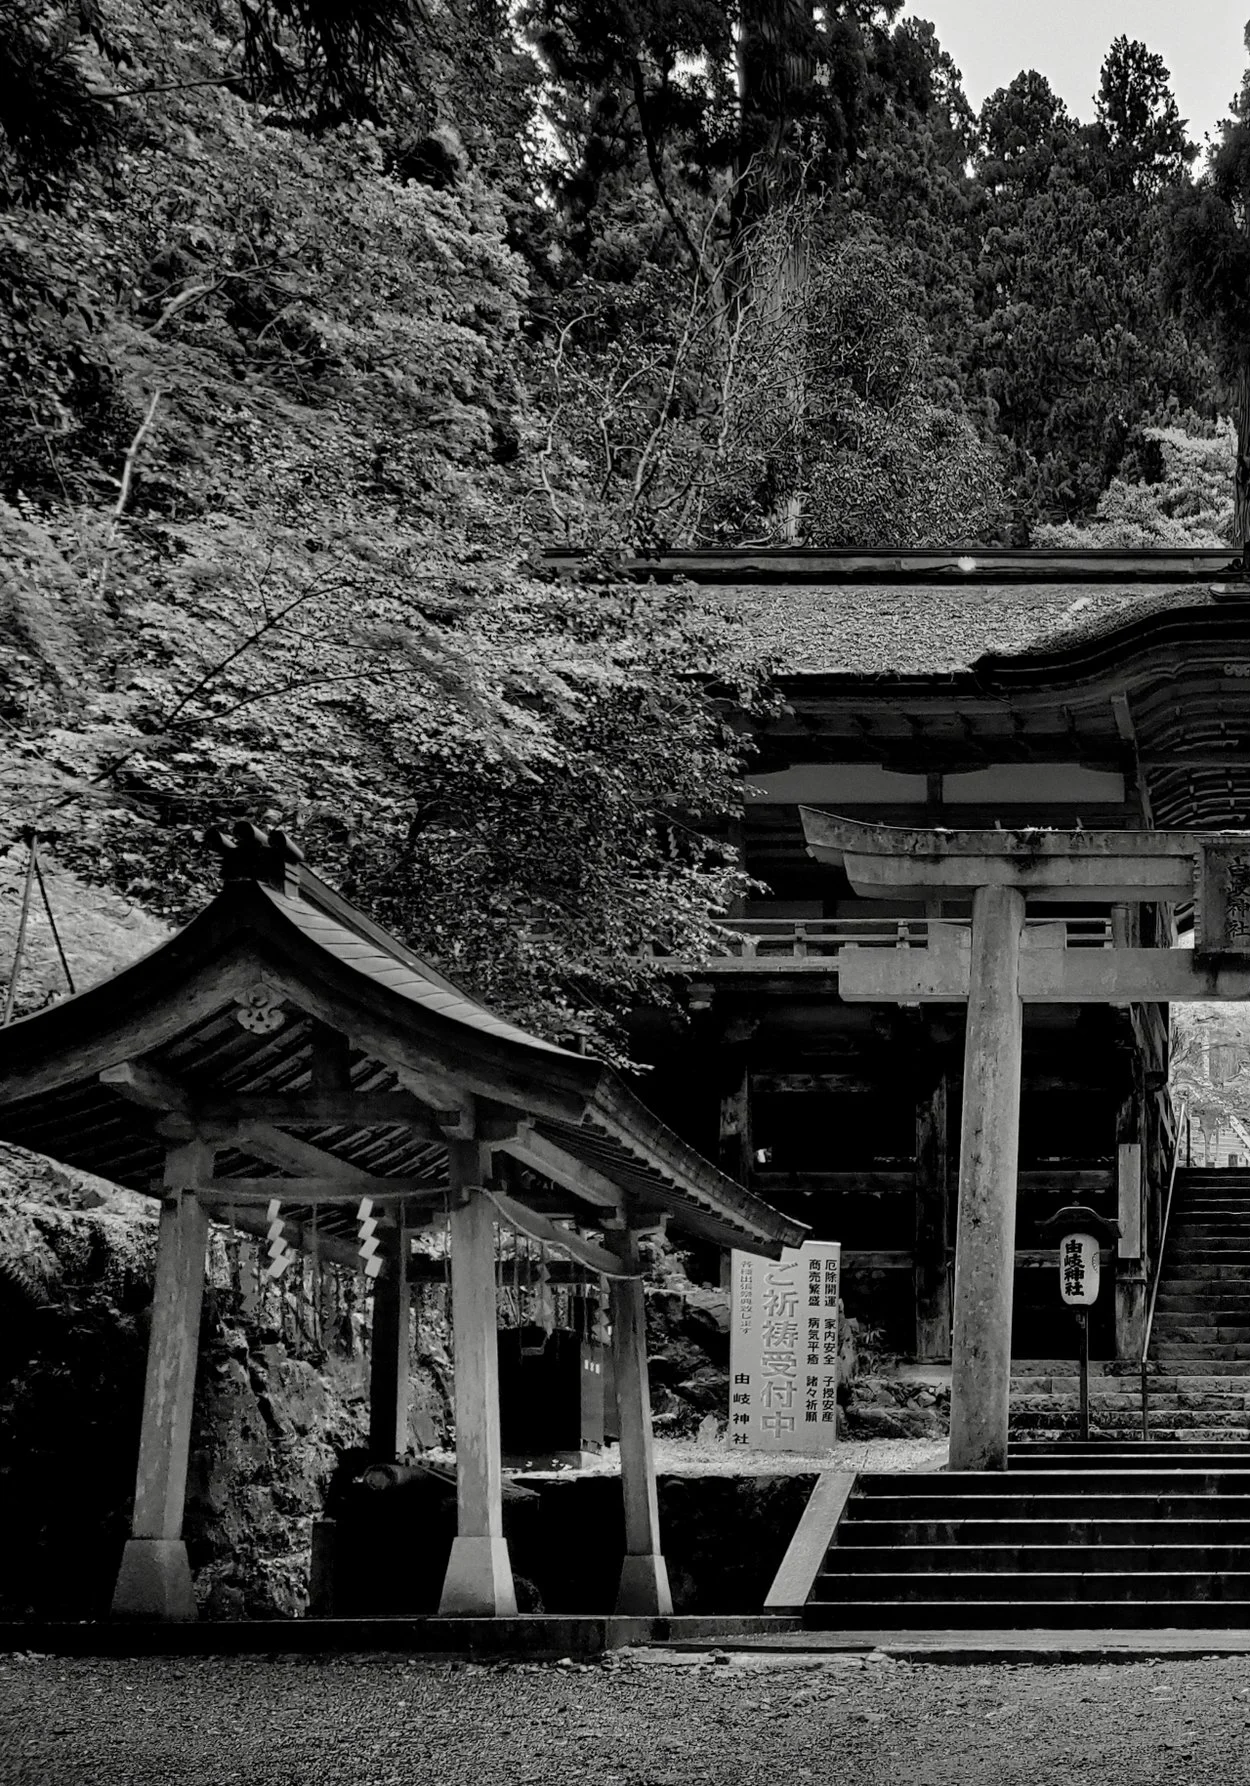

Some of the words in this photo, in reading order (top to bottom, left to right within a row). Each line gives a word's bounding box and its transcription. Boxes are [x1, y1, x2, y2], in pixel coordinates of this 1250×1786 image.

[808, 1259, 821, 1306] 商売繁盛
[825, 1259, 837, 1307] 厄除開運
[1064, 1239, 1085, 1296] 由岐神社
[761, 1261, 799, 1439] ご祈祷受付中
[807, 1317, 819, 1364] 病気平癒
[823, 1318, 836, 1365] 家内安全
[732, 1373, 750, 1444] 由岐神社
[805, 1375, 818, 1422] 諸々祈願
[822, 1376, 835, 1422] 子授安産
